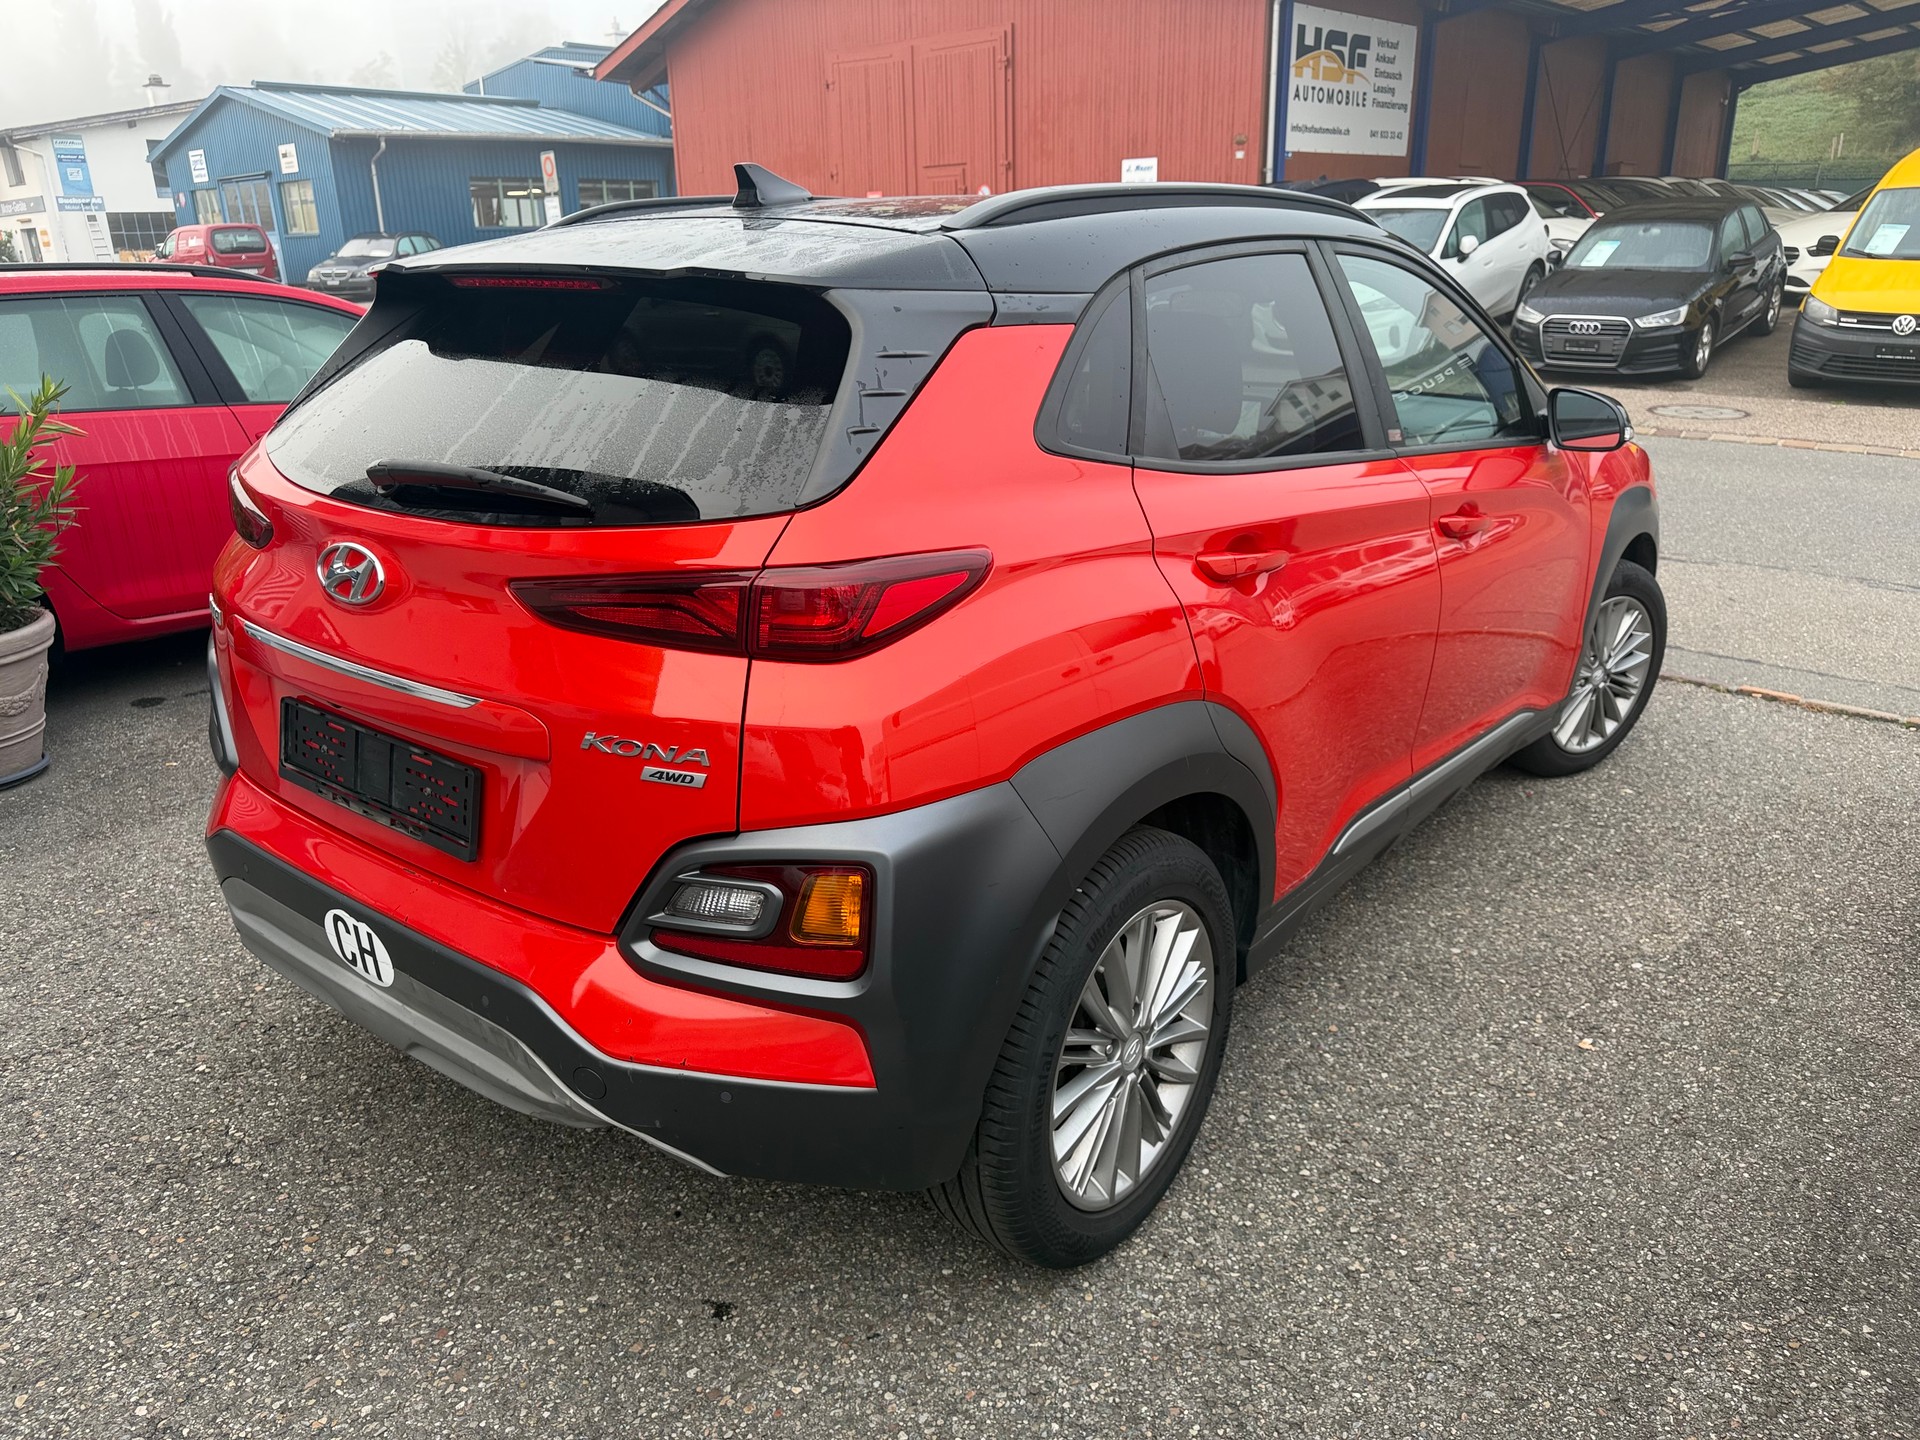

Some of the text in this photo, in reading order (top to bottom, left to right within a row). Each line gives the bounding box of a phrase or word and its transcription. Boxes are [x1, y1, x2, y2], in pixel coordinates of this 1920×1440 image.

[1376, 36, 1400, 50] Verkauf
[1294, 24, 1371, 84] HSF
[1375, 52, 1397, 65] Ankauf
[1374, 67, 1403, 81] Eintausch
[1293, 84, 1368, 108] AUTOMOBILE
[1373, 82, 1396, 98] Leasing
[1371, 97, 1408, 114] Finanzierung
[580, 731, 710, 767] KONA
[648, 770, 695, 785] 4WD
[332, 913, 385, 984] CH
